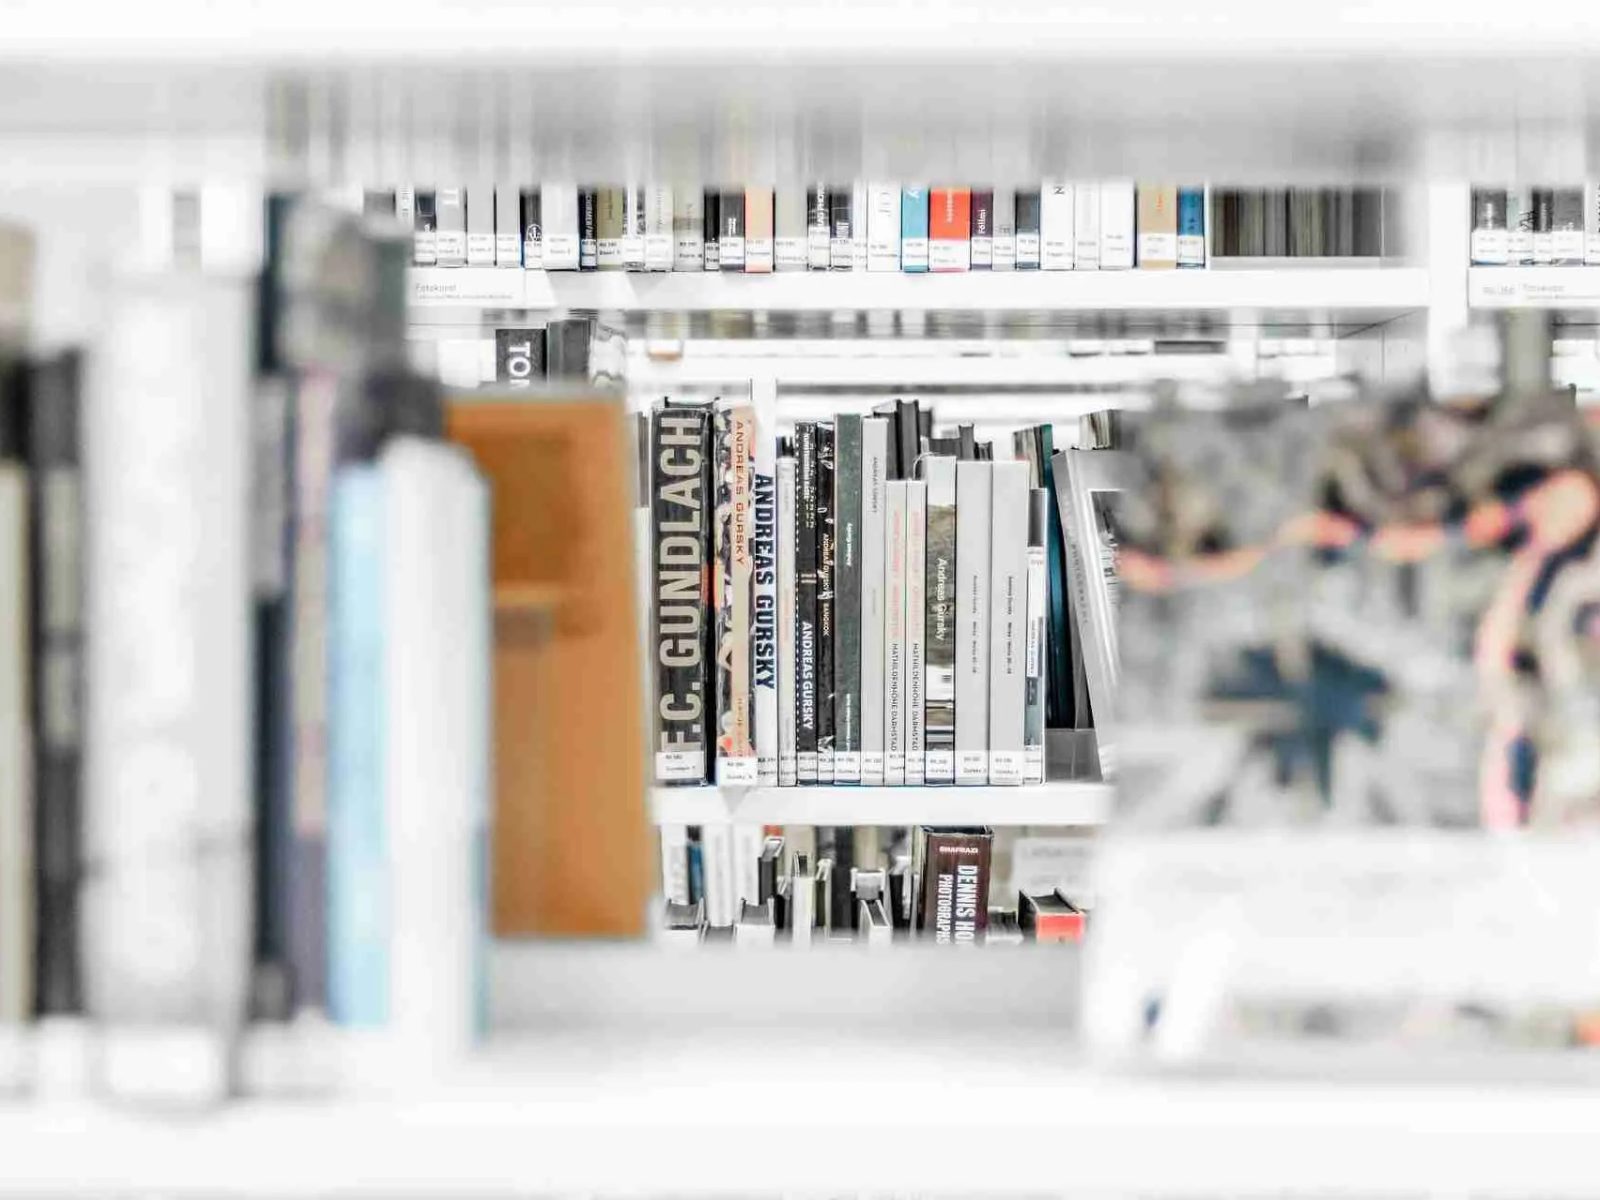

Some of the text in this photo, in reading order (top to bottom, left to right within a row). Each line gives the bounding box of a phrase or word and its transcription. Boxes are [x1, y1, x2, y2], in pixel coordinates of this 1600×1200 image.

[736, 420, 744, 566] ANDREAS GURSKY
[659, 417, 702, 668] GUNDLACH
[754, 474, 775, 689] ANDREAS GURSKY
[822, 533, 830, 563] ANDREAS
[822, 603, 830, 636] BANGKOK
[934, 557, 948, 640] Andreas Gursky
[802, 621, 813, 730] ANDREAS GURSKY
[956, 865, 978, 918] DENNIS
